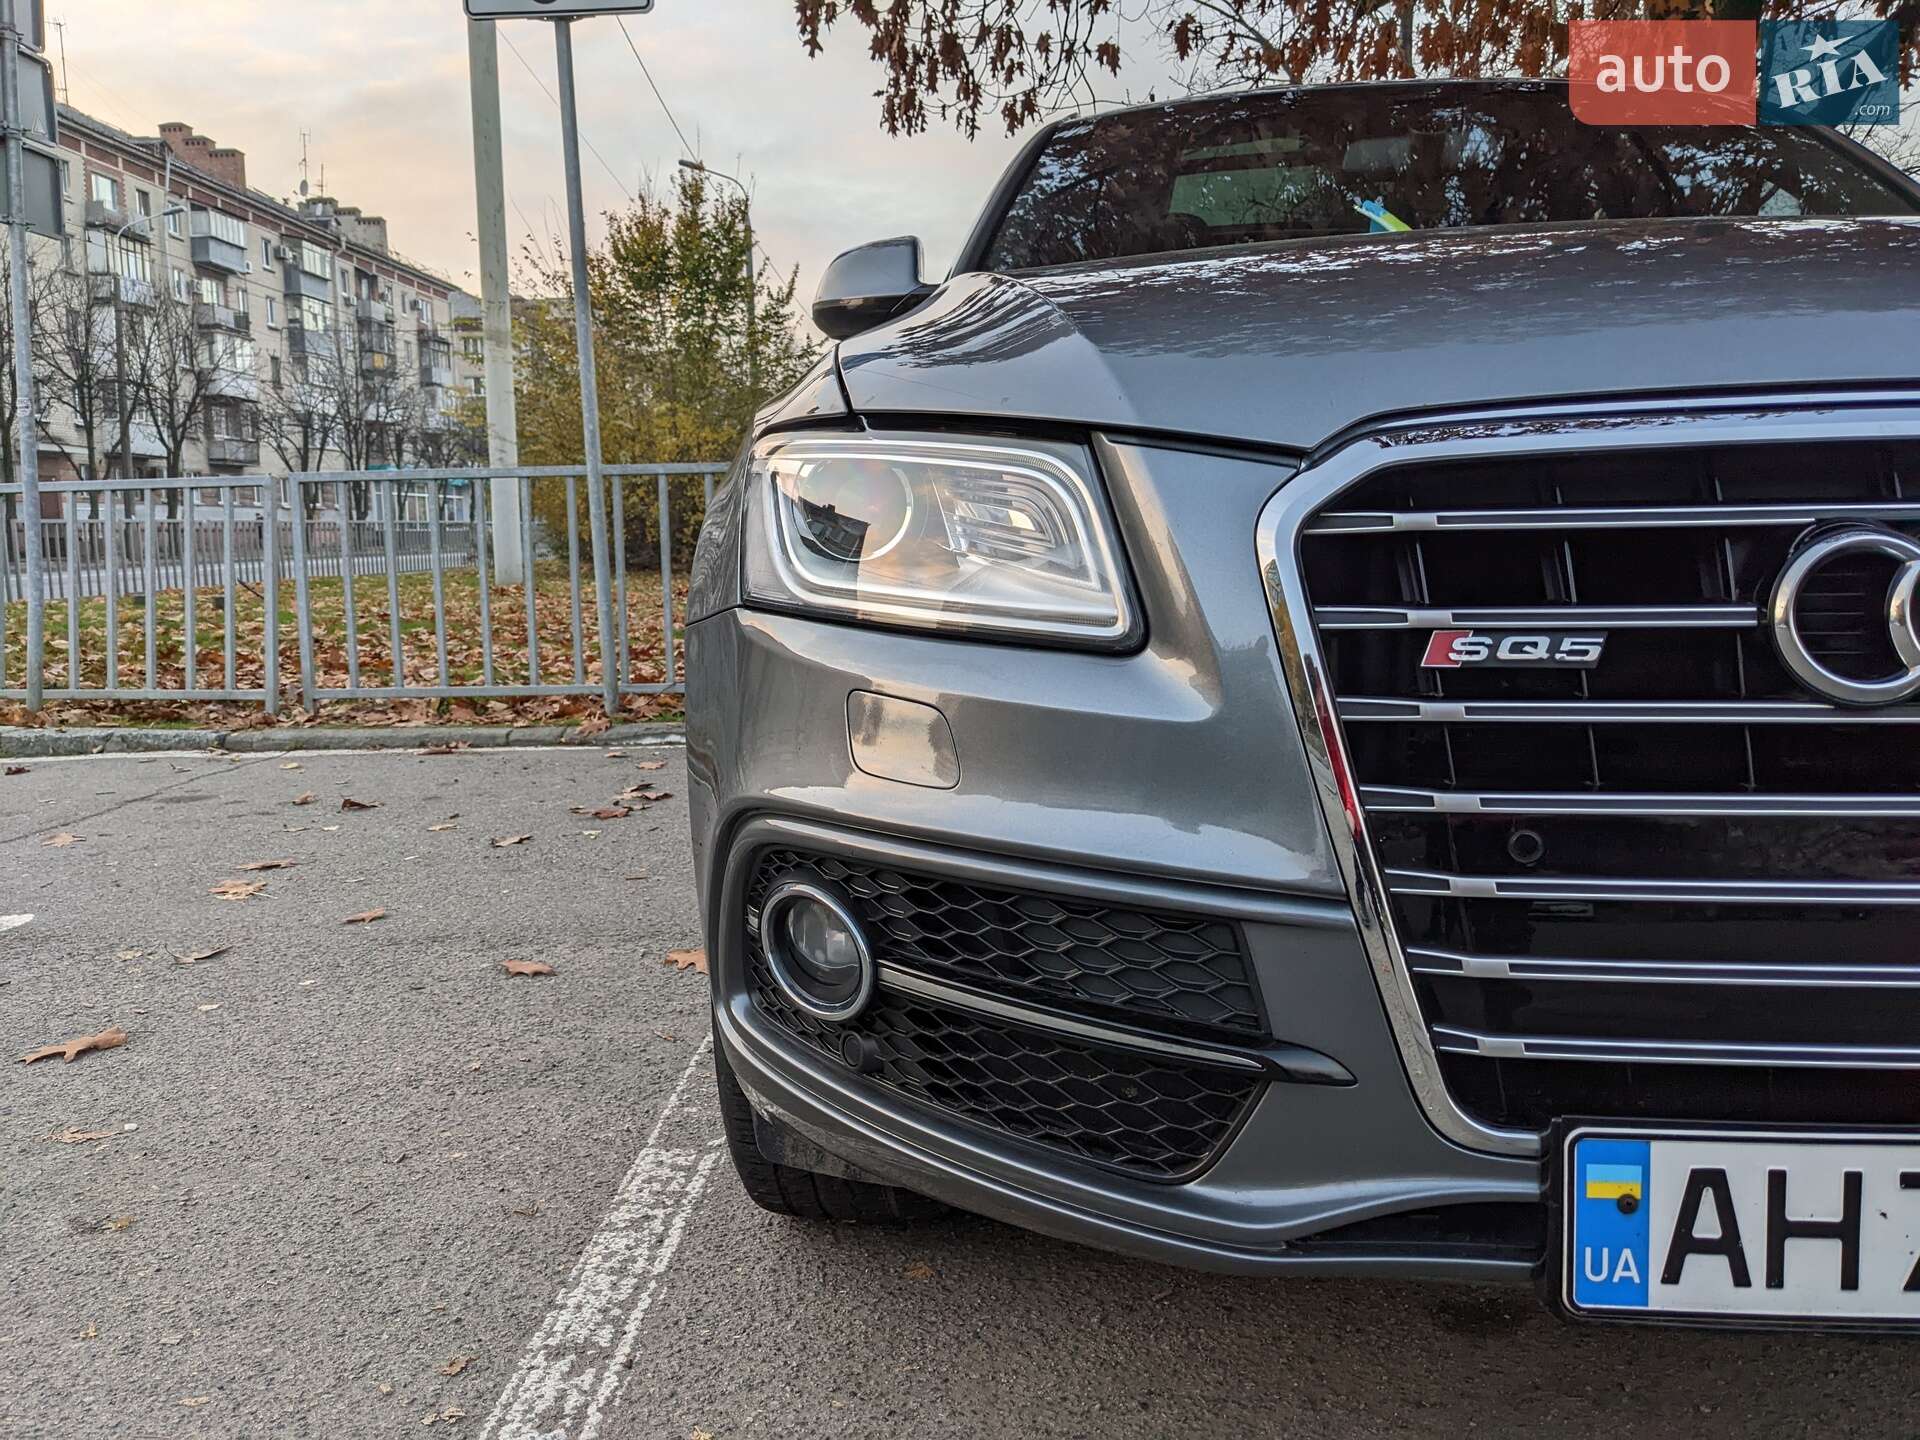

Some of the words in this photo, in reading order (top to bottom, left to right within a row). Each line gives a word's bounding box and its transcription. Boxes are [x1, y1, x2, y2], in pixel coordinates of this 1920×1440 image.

[1448, 636, 1604, 662] SQ5
[1660, 1167, 1864, 1291] AH
[1584, 1247, 1641, 1284] UA
